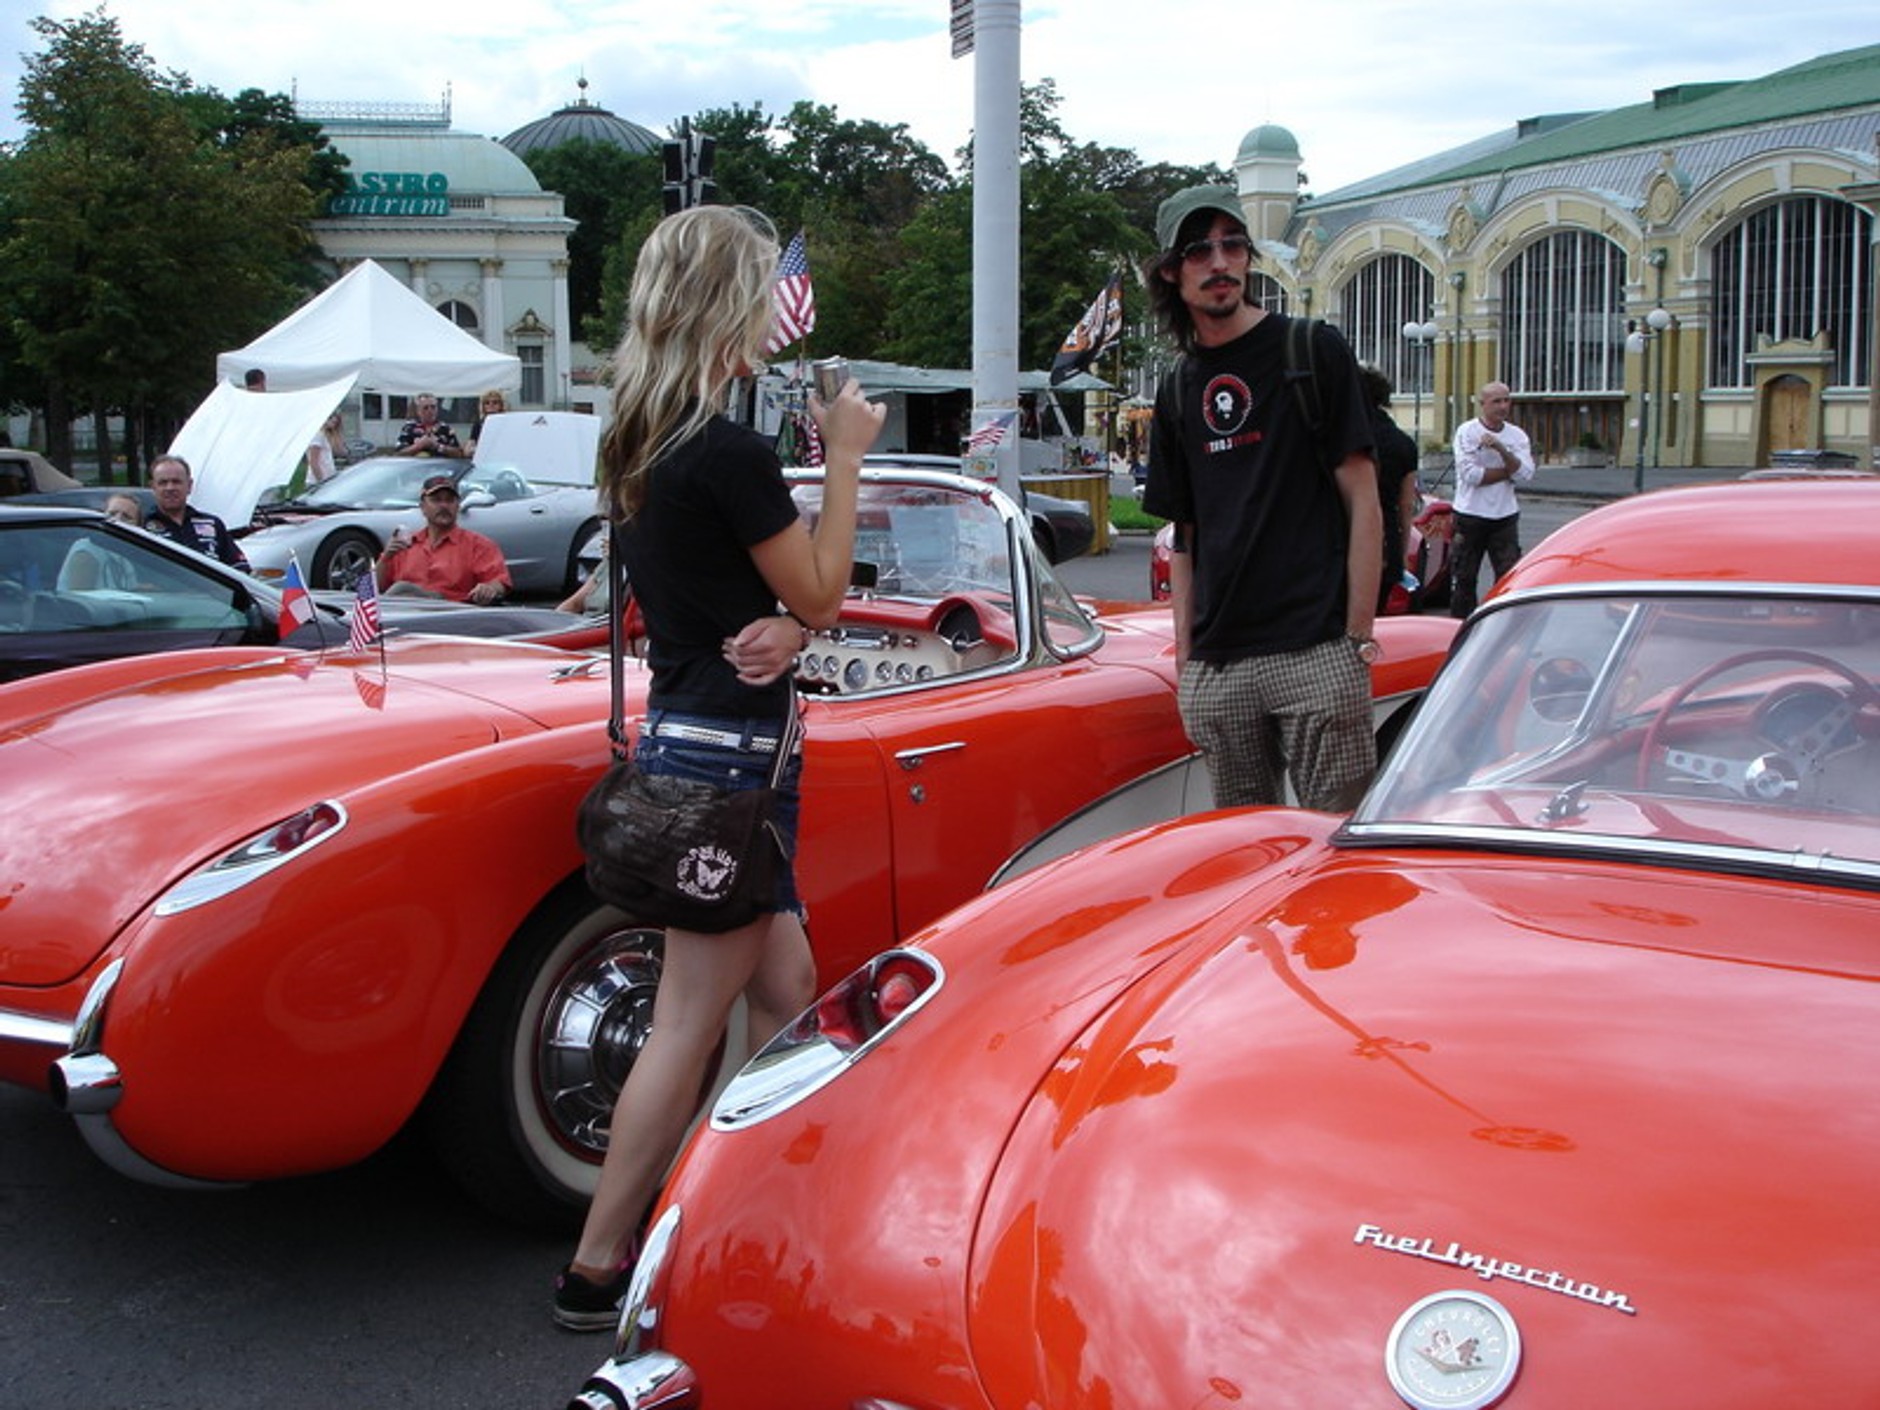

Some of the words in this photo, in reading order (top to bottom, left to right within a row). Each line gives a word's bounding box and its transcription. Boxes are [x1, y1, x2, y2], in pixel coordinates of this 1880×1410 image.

[330, 196, 446, 215] entrum
[1353, 1223, 1442, 1261] Fuel
[1446, 1242, 1637, 1315] Injection
[1414, 1309, 1502, 1354] CHEVROLET
